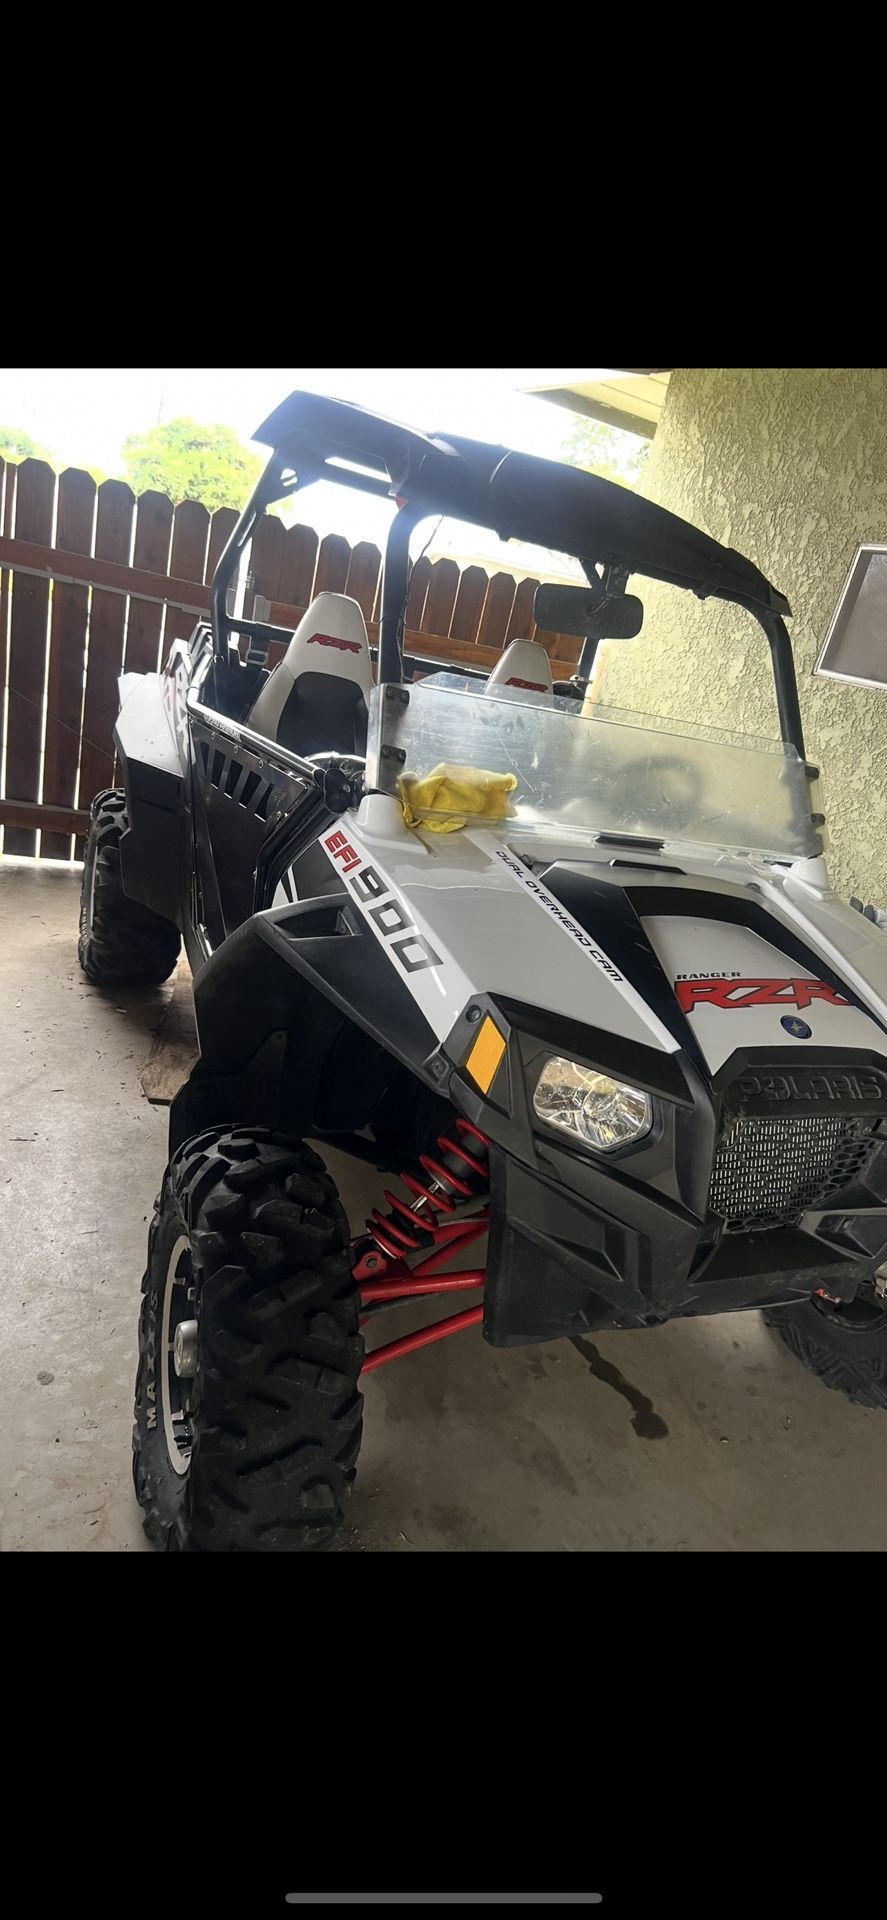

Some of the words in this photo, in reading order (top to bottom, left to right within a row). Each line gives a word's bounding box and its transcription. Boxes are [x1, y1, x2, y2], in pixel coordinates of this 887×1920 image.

[306, 632, 363, 654] RZR
[324, 831, 362, 873] EFI
[349, 866, 444, 973] 900
[495, 850, 524, 878] DUAL
[526, 880, 590, 947] OVERHEAD
[589, 949, 623, 982] CAM
[676, 971, 741, 980] RANGER
[674, 978, 857, 1014] RZR
[740, 1076, 882, 1102] POLARIS
